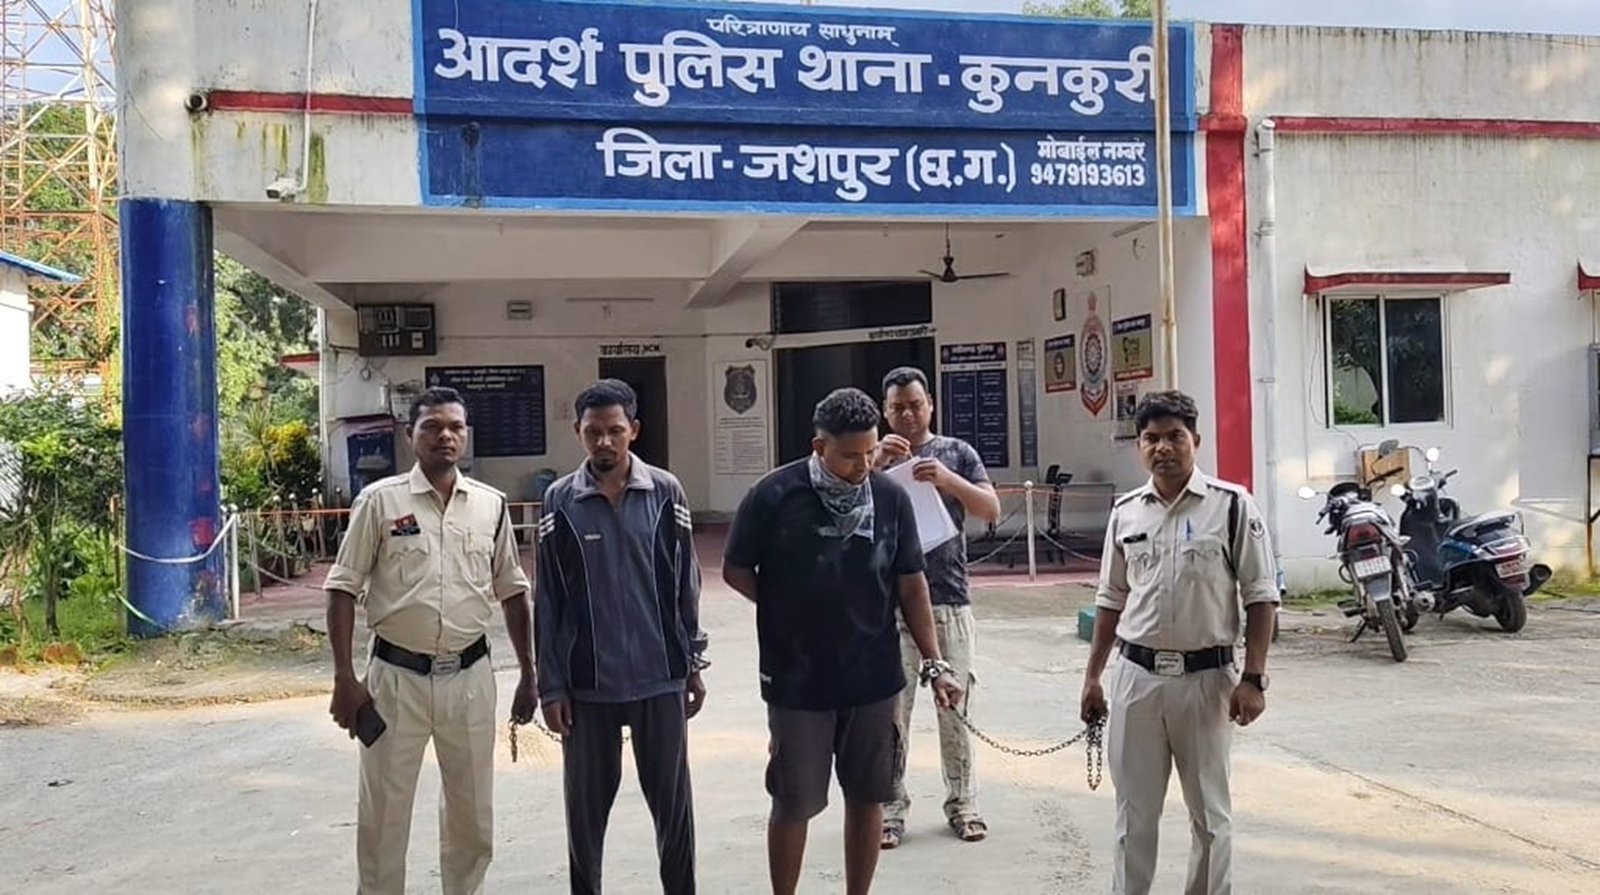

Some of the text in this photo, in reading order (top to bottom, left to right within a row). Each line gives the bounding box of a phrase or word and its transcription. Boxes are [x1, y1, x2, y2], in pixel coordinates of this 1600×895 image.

[706, 14, 811, 37] परित्राणाय
[435, 28, 603, 89] आदर्श
[619, 30, 783, 107] पुलिस
[798, 45, 932, 92] थाना
[959, 45, 1155, 115] कुनकुरी
[1030, 162, 1146, 187] 9479193613
